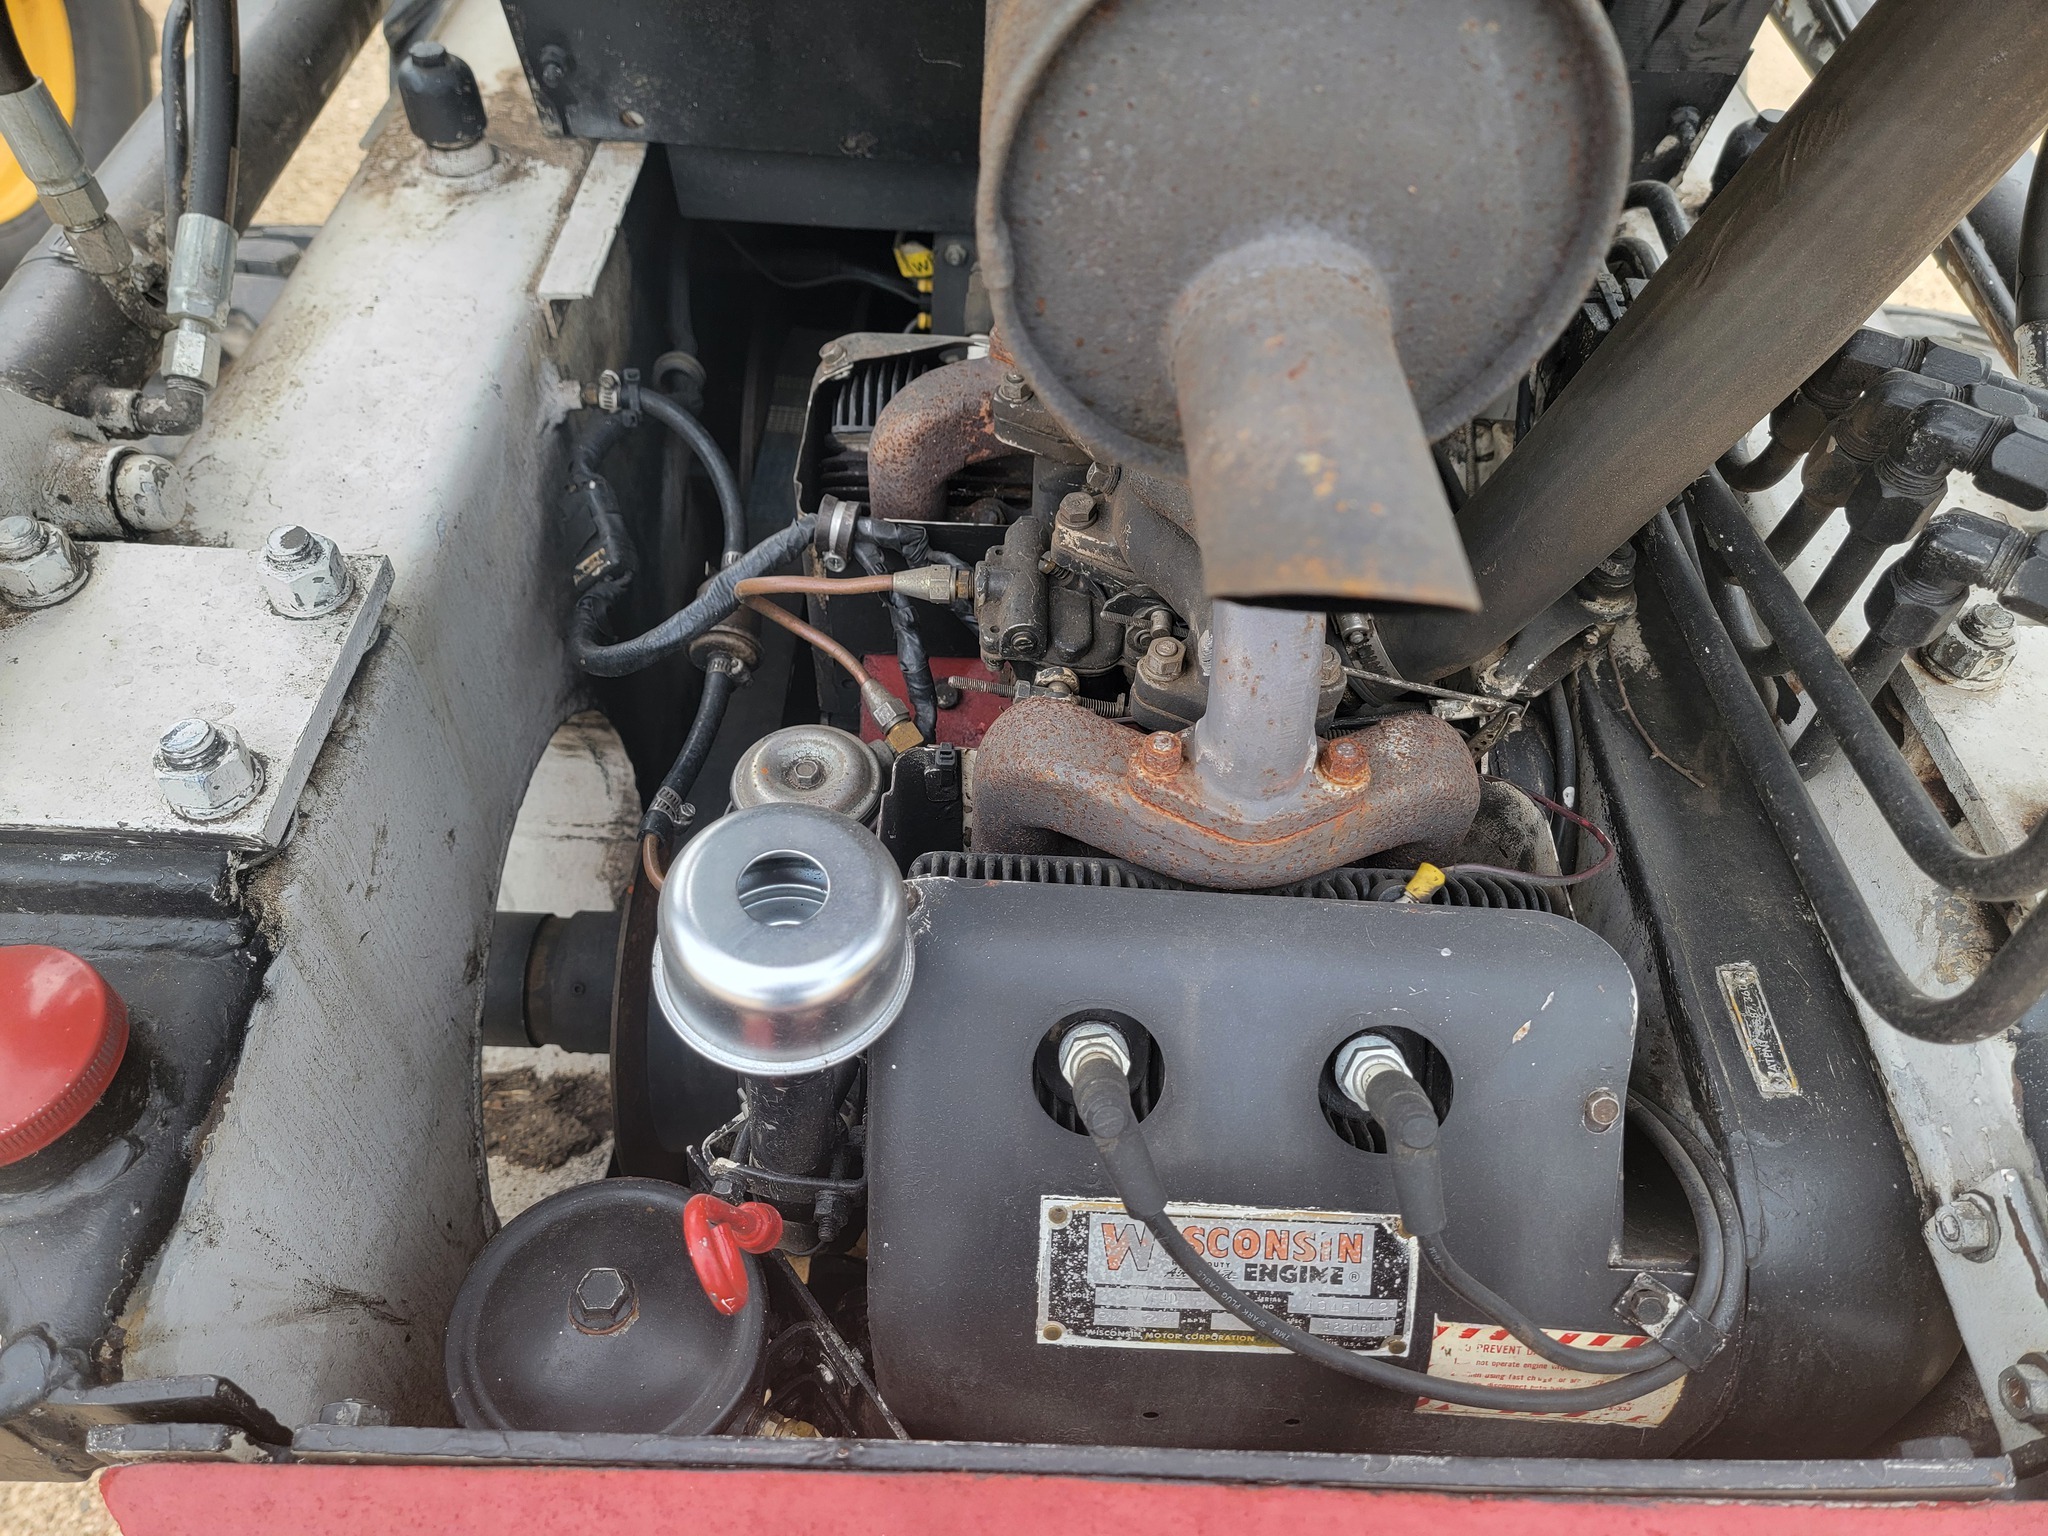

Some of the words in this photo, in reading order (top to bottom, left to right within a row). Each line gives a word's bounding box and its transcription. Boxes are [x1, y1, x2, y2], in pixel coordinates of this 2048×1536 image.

[1101, 1222, 1365, 1272] WSCONSIN
[1243, 1262, 1344, 1286] ENGINE
[1220, 1291, 1241, 1309] PLUG
[1241, 1308, 1267, 1328] SPARK
[1145, 1331, 1182, 1340] MOTOR
[1185, 1333, 1255, 1342] CORPORATION
[1476, 1343, 1523, 1355] PREVENT
[1491, 1360, 1520, 1369] operate
[1523, 1362, 1548, 1370] engine
[1508, 1373, 1524, 1381] fast
